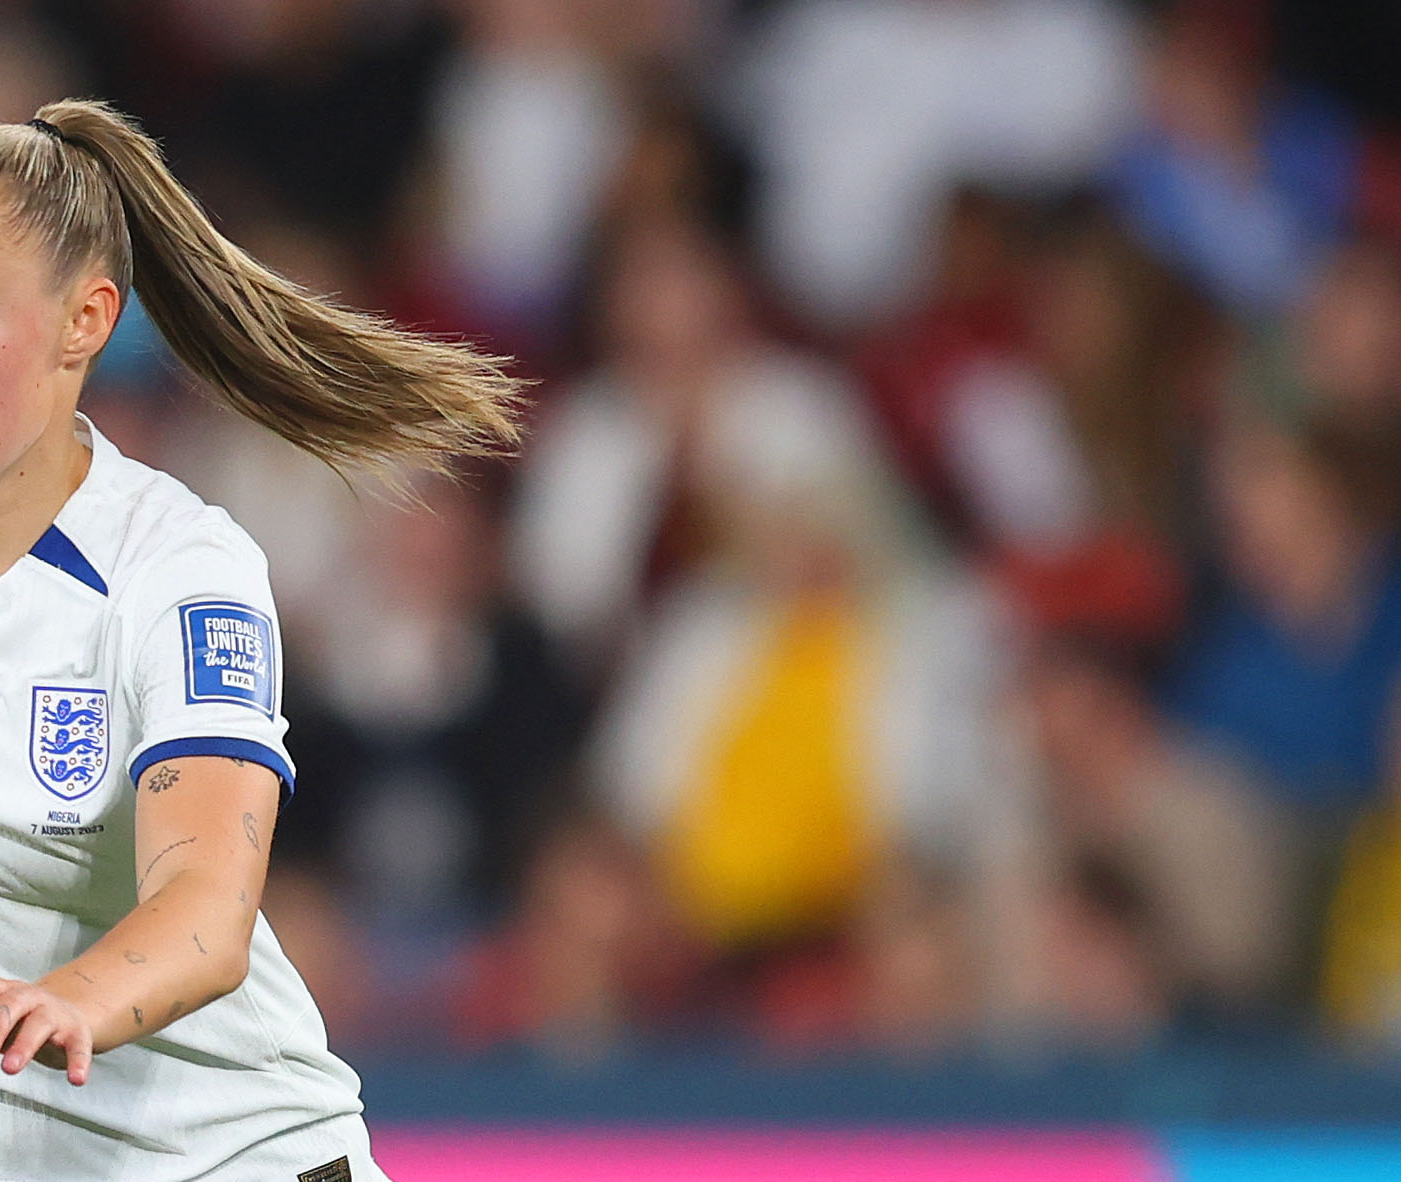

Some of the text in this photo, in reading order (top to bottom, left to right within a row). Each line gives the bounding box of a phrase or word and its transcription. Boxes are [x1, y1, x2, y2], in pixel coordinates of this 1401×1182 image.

[204, 617, 262, 640] FOOTBALL
[205, 631, 264, 658] UNITES
[203, 651, 267, 679] the World
[227, 674, 251, 686] FIFA
[47, 810, 81, 825] NIGERIA
[30, 823, 105, 836] 7 AUGUST 2023
